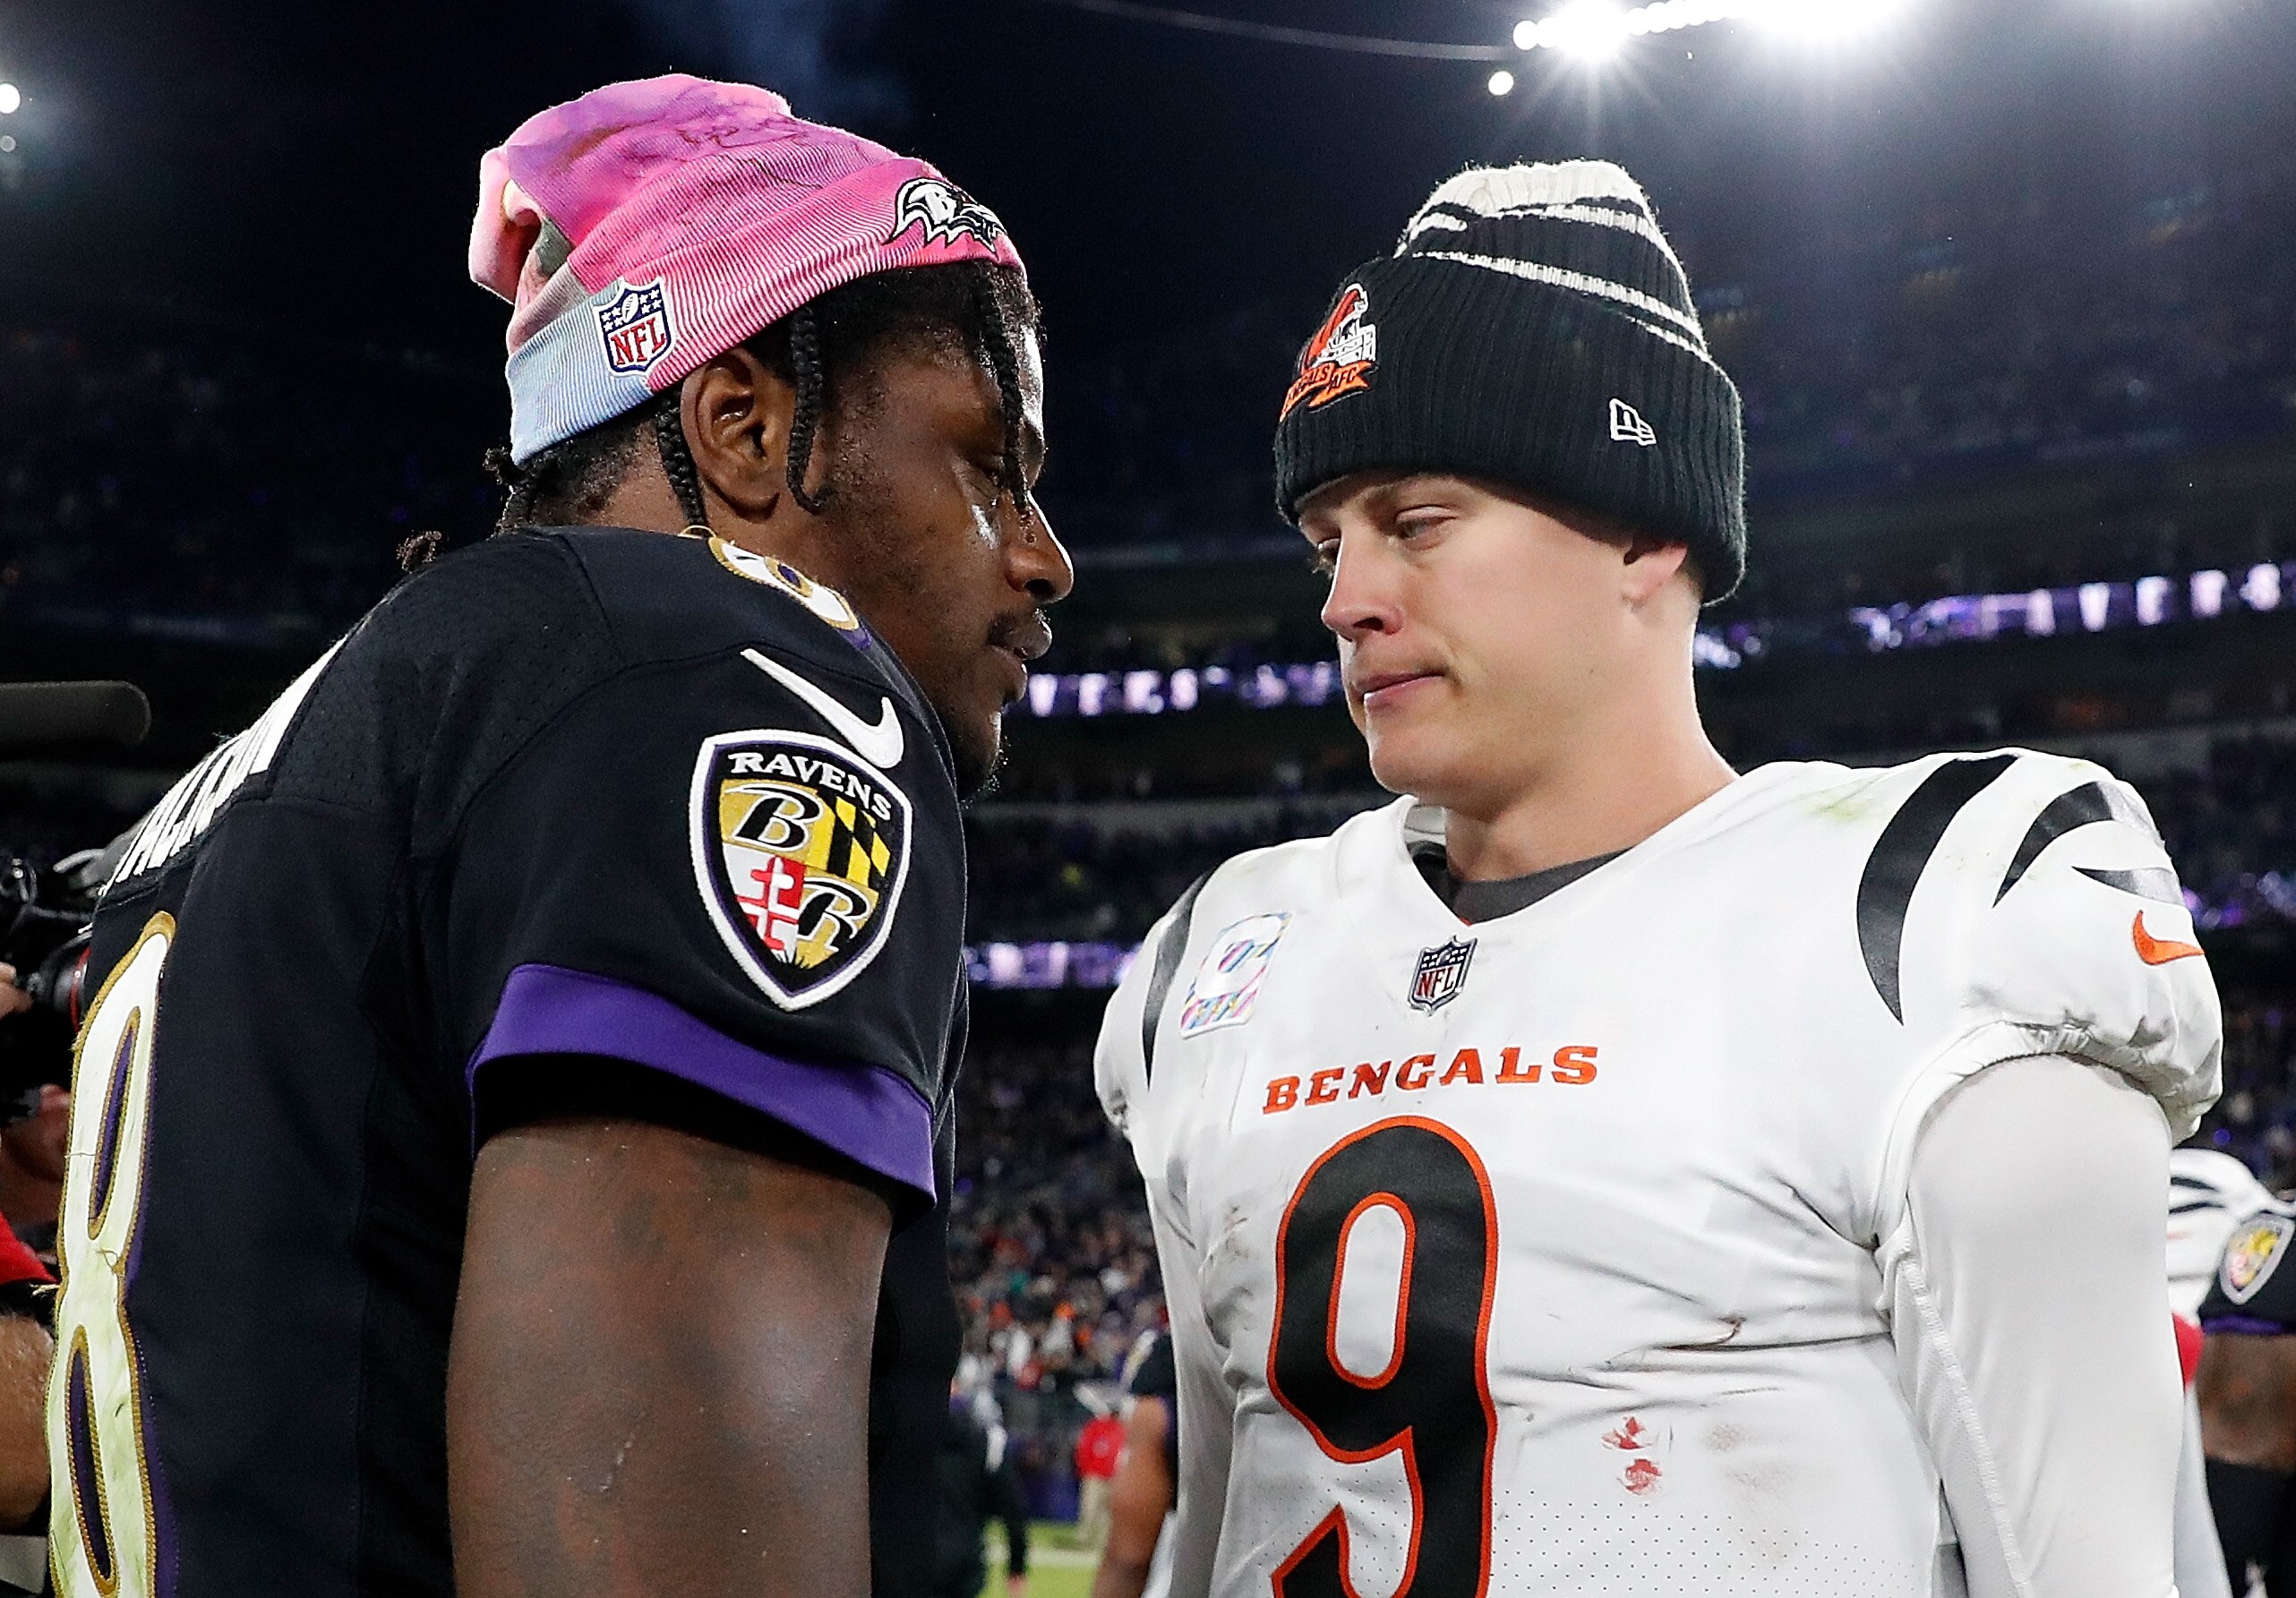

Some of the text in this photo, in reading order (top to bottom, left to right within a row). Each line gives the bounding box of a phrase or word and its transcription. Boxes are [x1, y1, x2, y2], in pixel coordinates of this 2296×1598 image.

[611, 317, 666, 365] NFL
[724, 782, 825, 852] B
[728, 752, 892, 821] RAVENS
[1417, 966, 1455, 998] NFL
[1262, 1046, 1598, 1115] BENGALS
[45, 910, 176, 1598] 8
[1266, 1115, 1499, 1598] 9
